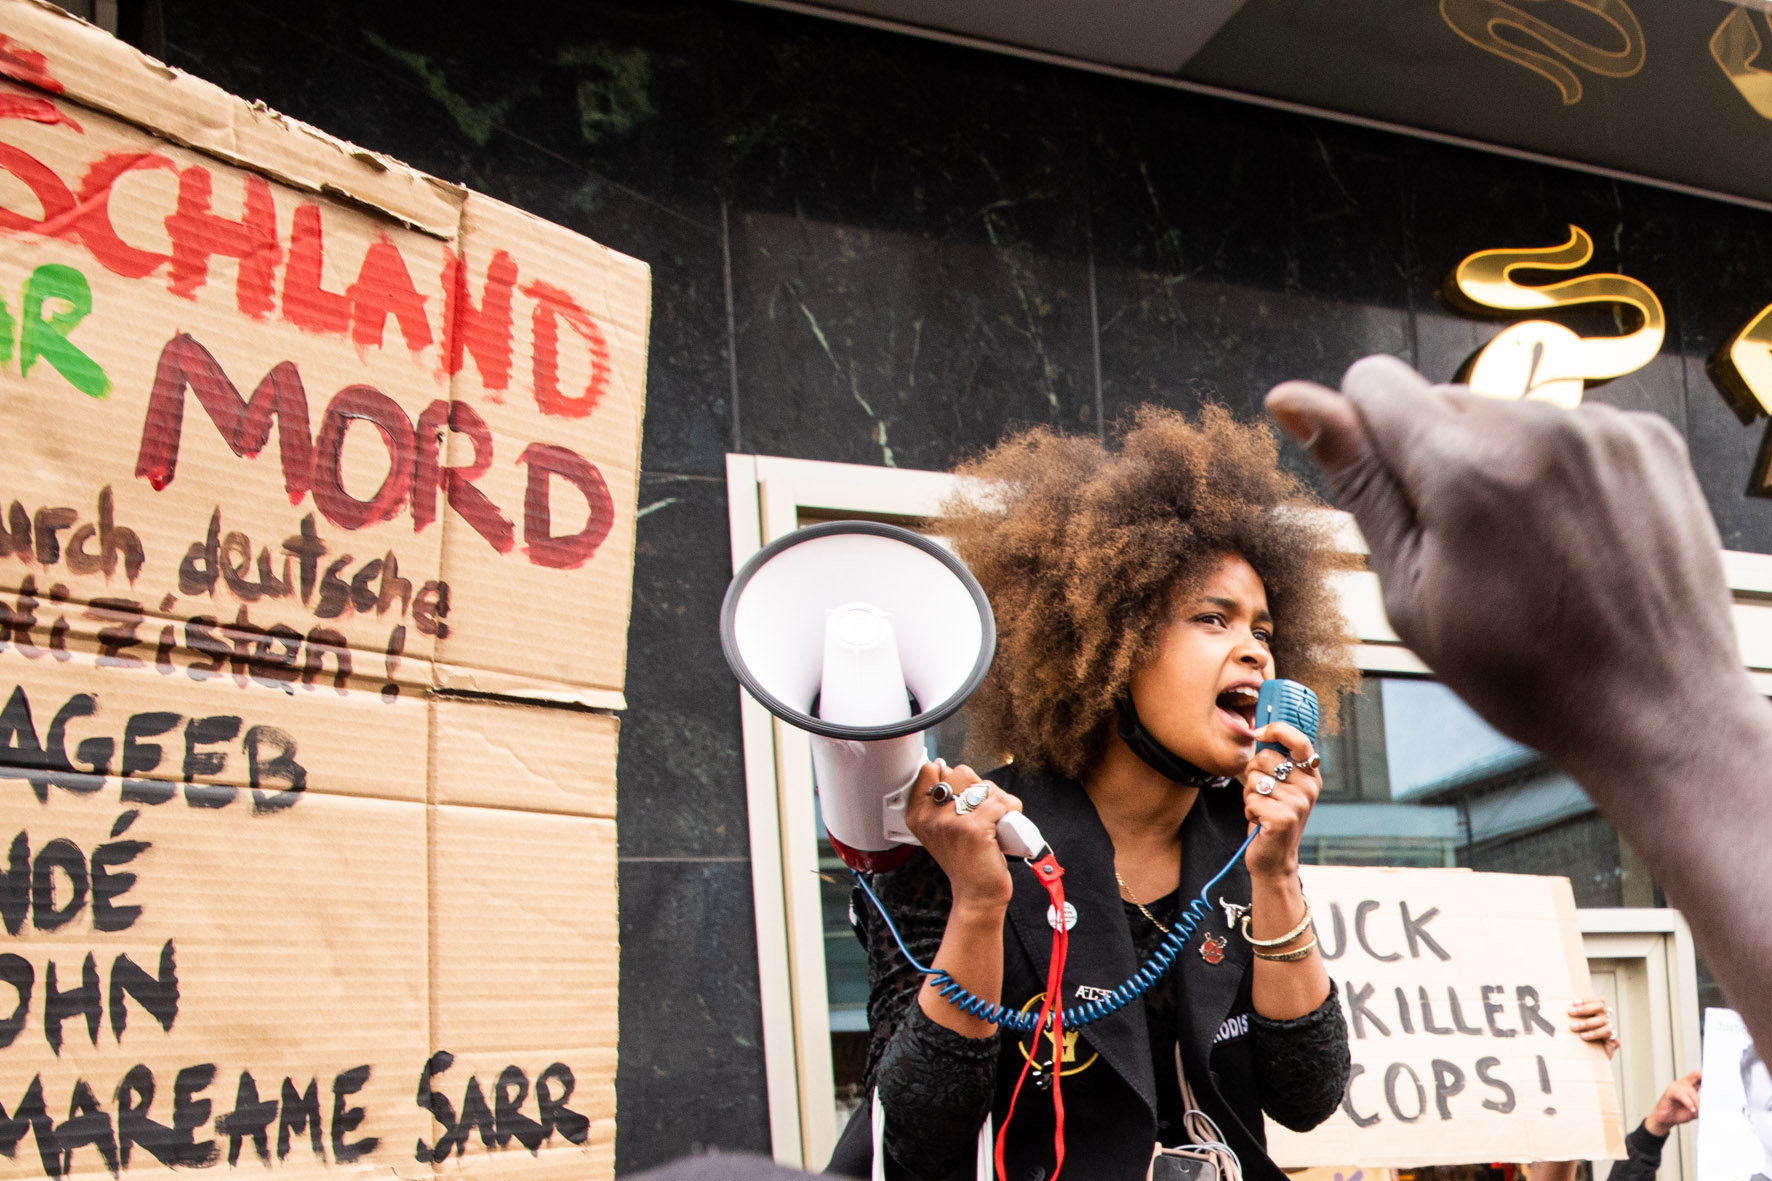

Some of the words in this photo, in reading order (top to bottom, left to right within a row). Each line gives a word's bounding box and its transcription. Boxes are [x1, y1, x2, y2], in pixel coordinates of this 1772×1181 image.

[136, 328, 614, 570] MORD
[178, 505, 451, 640] deutsche
[1345, 981, 1557, 1039] KILLER
[416, 1050, 591, 1164] SARR
